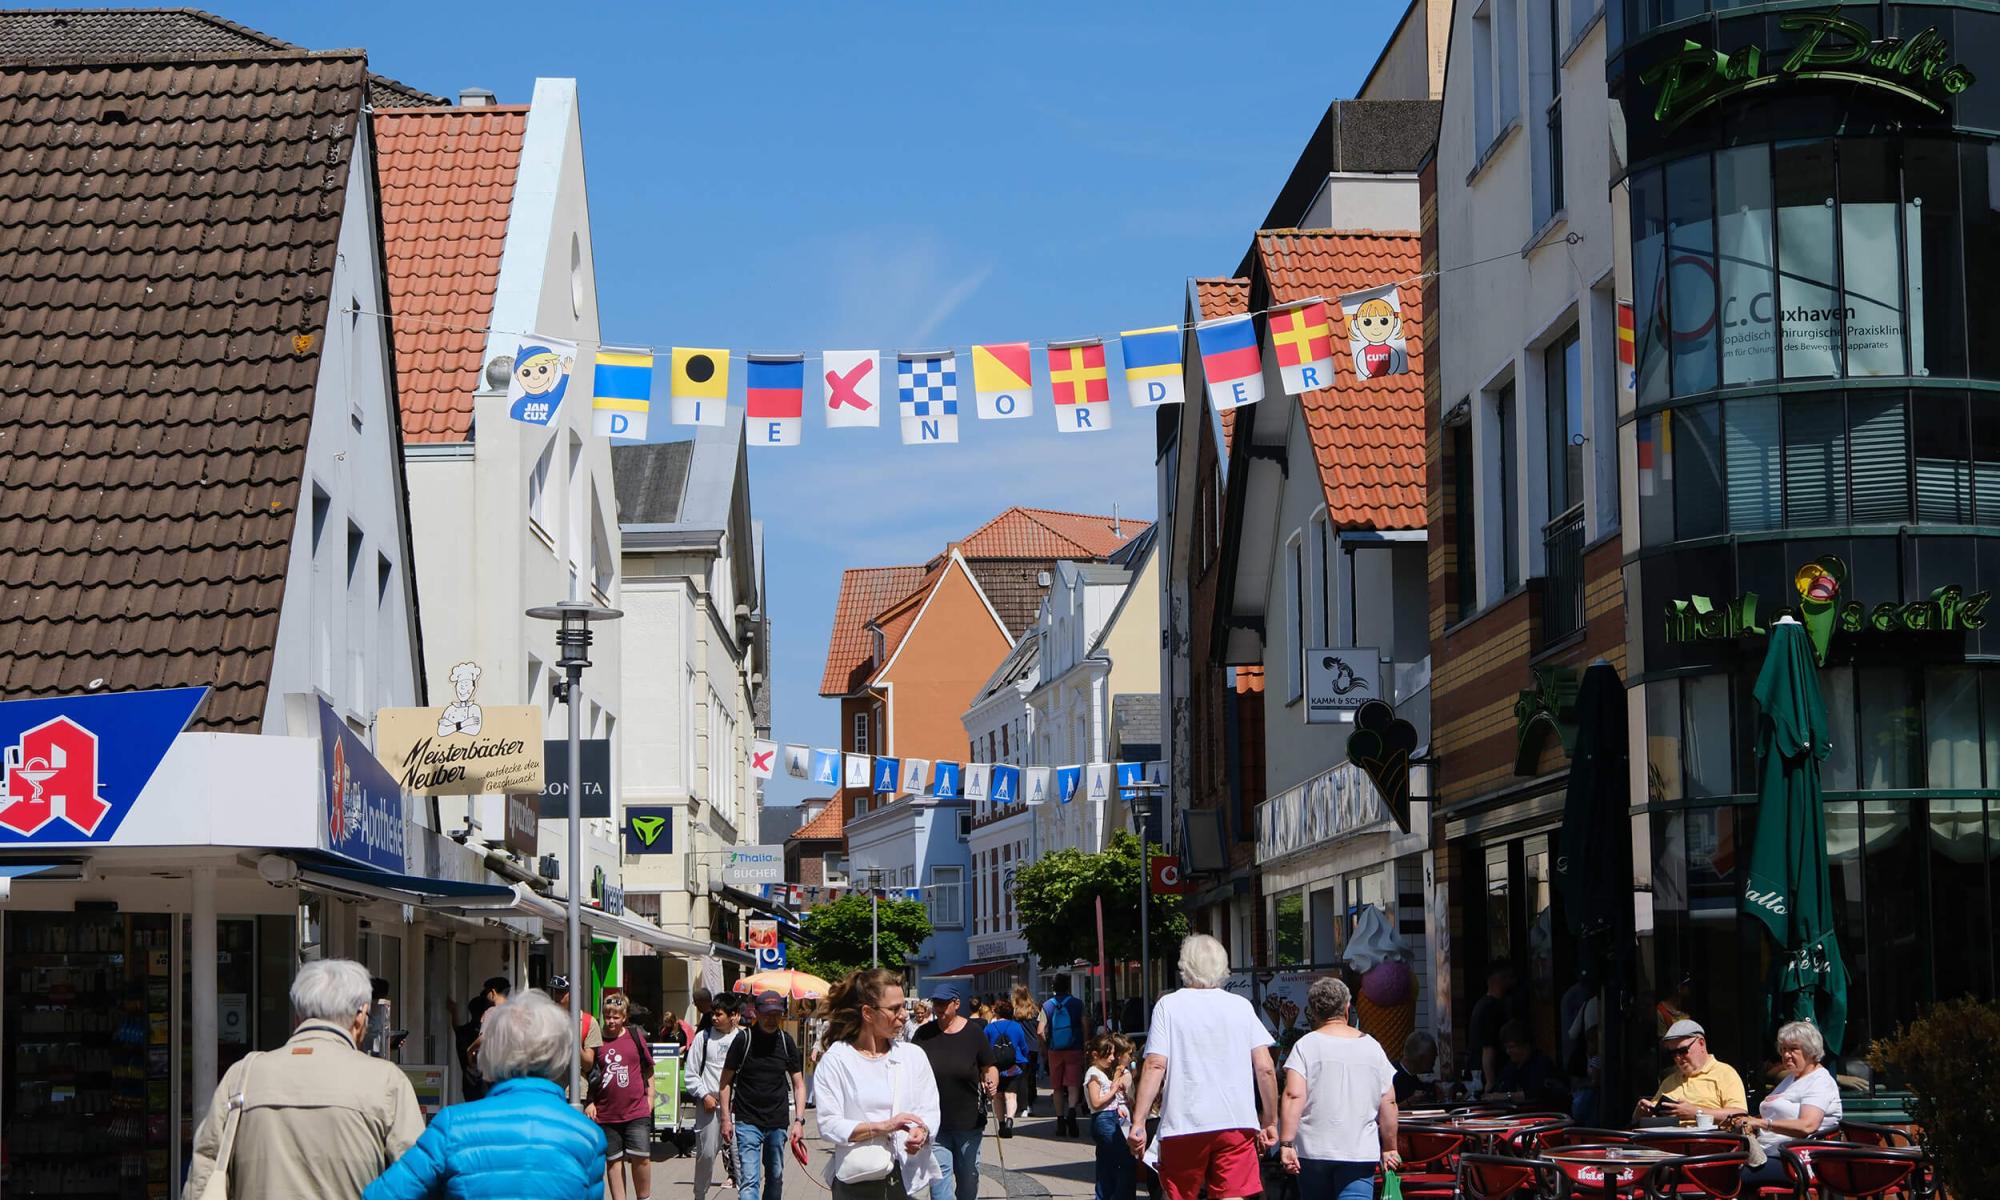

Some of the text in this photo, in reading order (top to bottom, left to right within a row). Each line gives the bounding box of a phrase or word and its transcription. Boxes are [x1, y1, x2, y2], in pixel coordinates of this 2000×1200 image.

[523, 410, 549, 421] CUX
[524, 402, 549, 413] JAN
[1311, 697, 1336, 705] KAMM
[402, 736, 526, 768] Meisterbäcker
[400, 763, 467, 791] Neuber
[485, 771, 537, 792] Geschmack!
[538, 781, 603, 796] ONTA
[361, 788, 403, 860] Apotheke
[1745, 880, 1788, 915] alto
